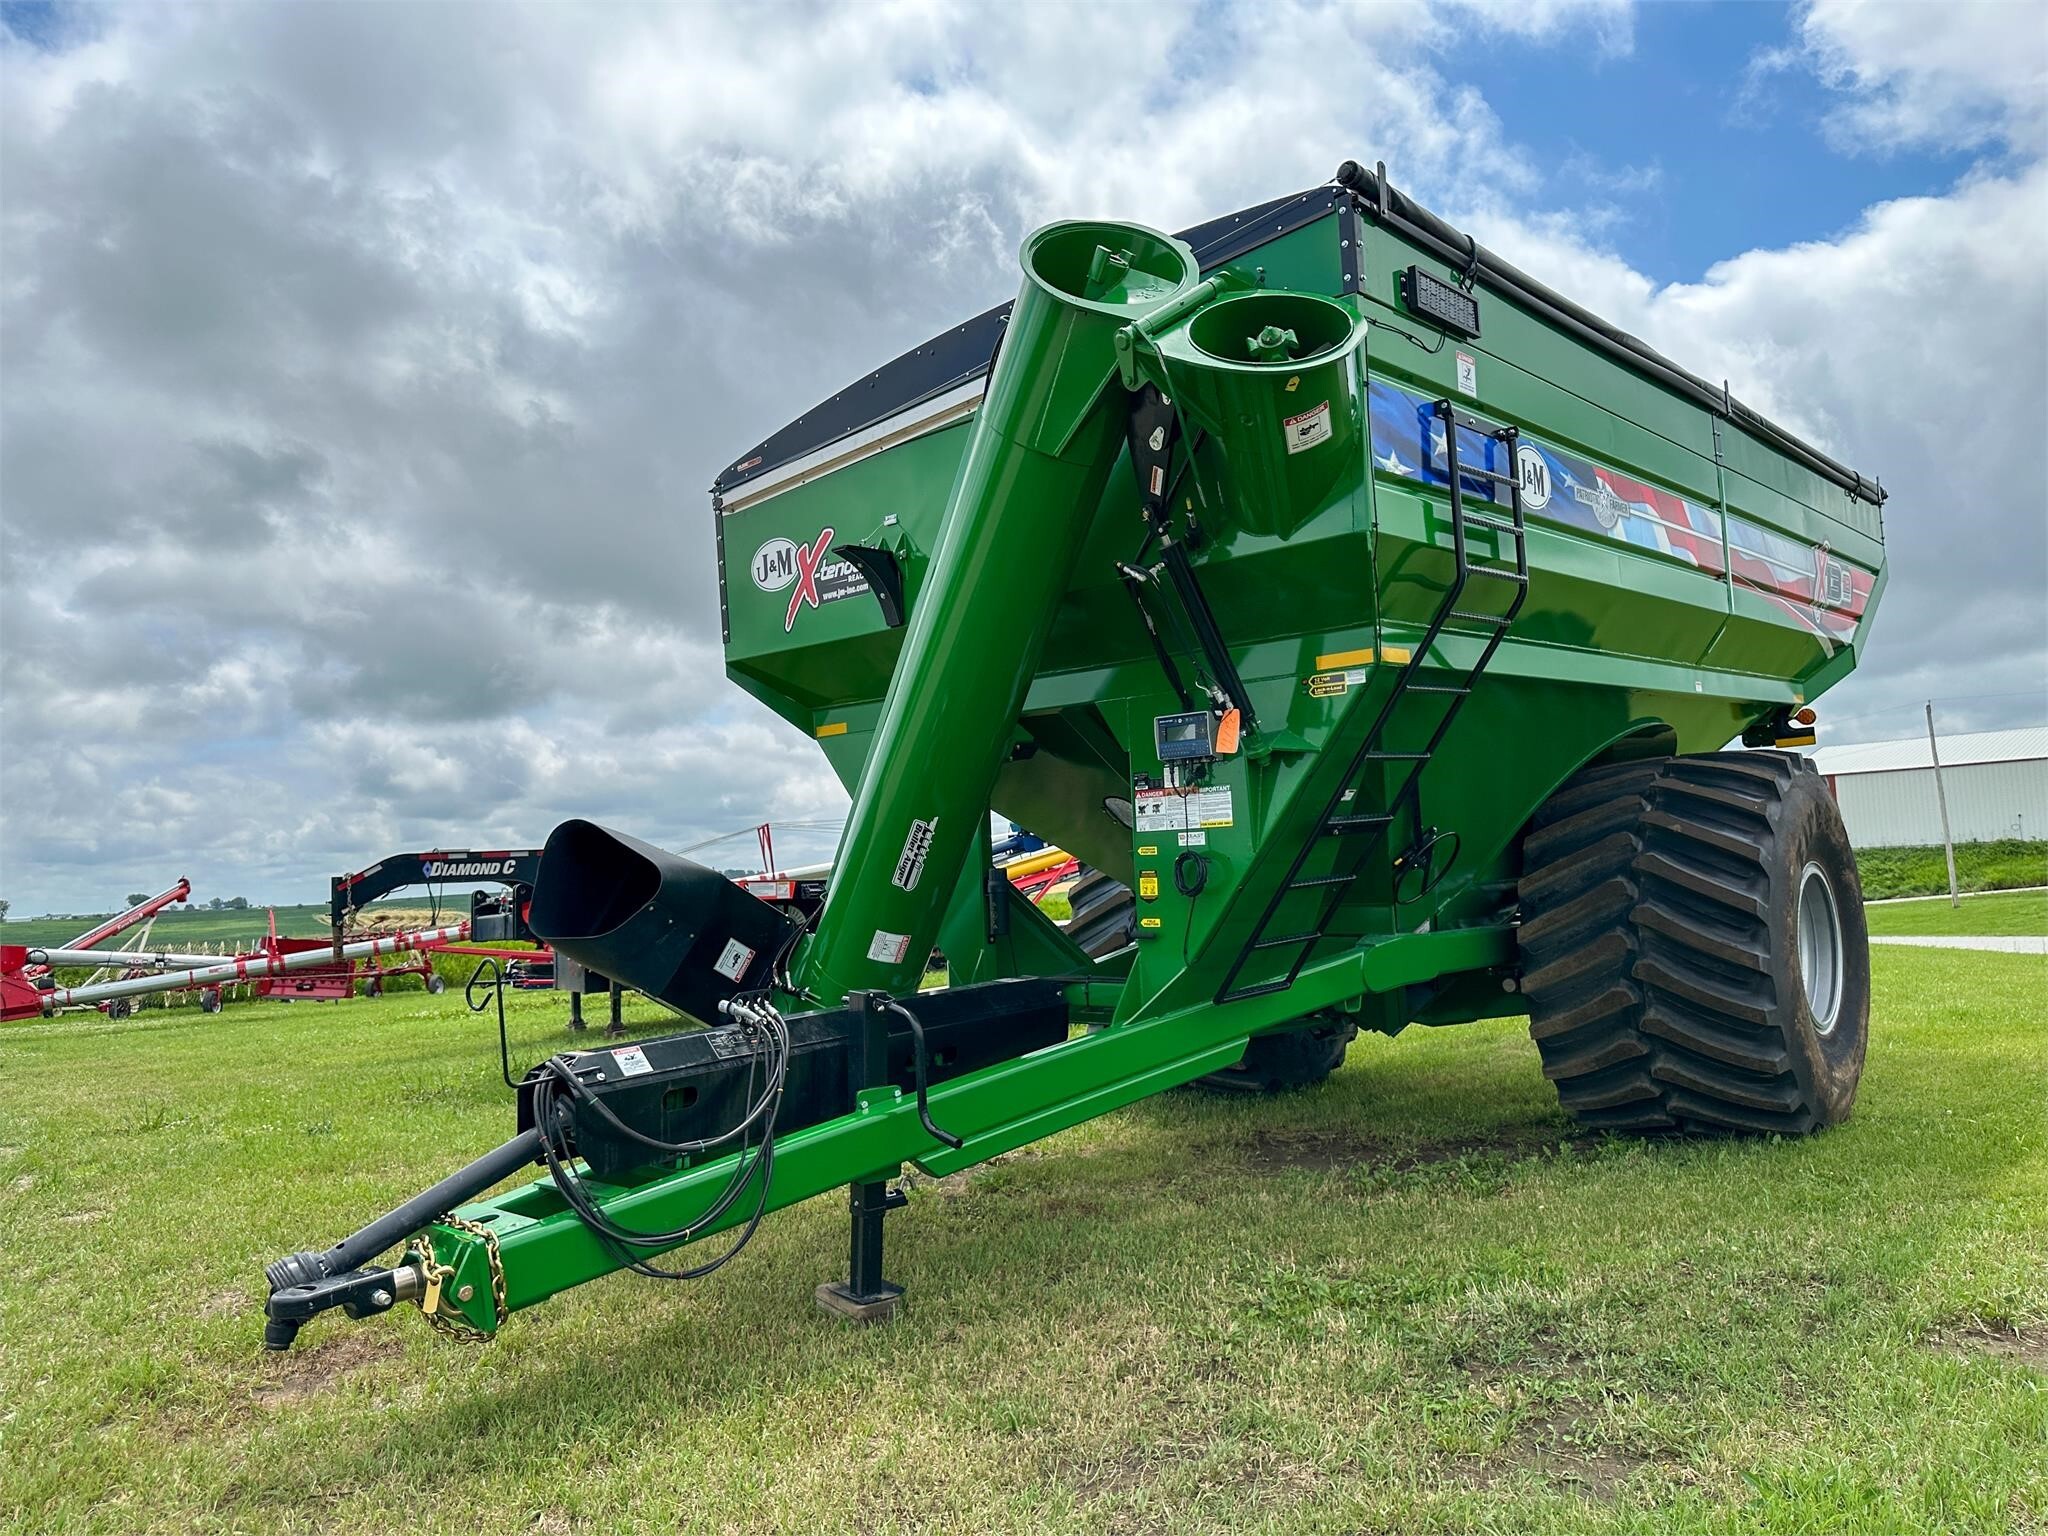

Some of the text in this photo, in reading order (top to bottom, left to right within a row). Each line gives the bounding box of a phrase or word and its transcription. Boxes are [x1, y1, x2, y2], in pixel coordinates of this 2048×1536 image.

[1297, 405, 1325, 421] DANGER
[1520, 458, 1546, 498] J&M
[756, 547, 793, 583] J&M
[847, 572, 865, 583] REAC
[822, 582, 869, 600] www.jm-inc.com
[1141, 790, 1164, 798] DANGER
[897, 823, 924, 884] Bullet Auger
[502, 860, 516, 874] C
